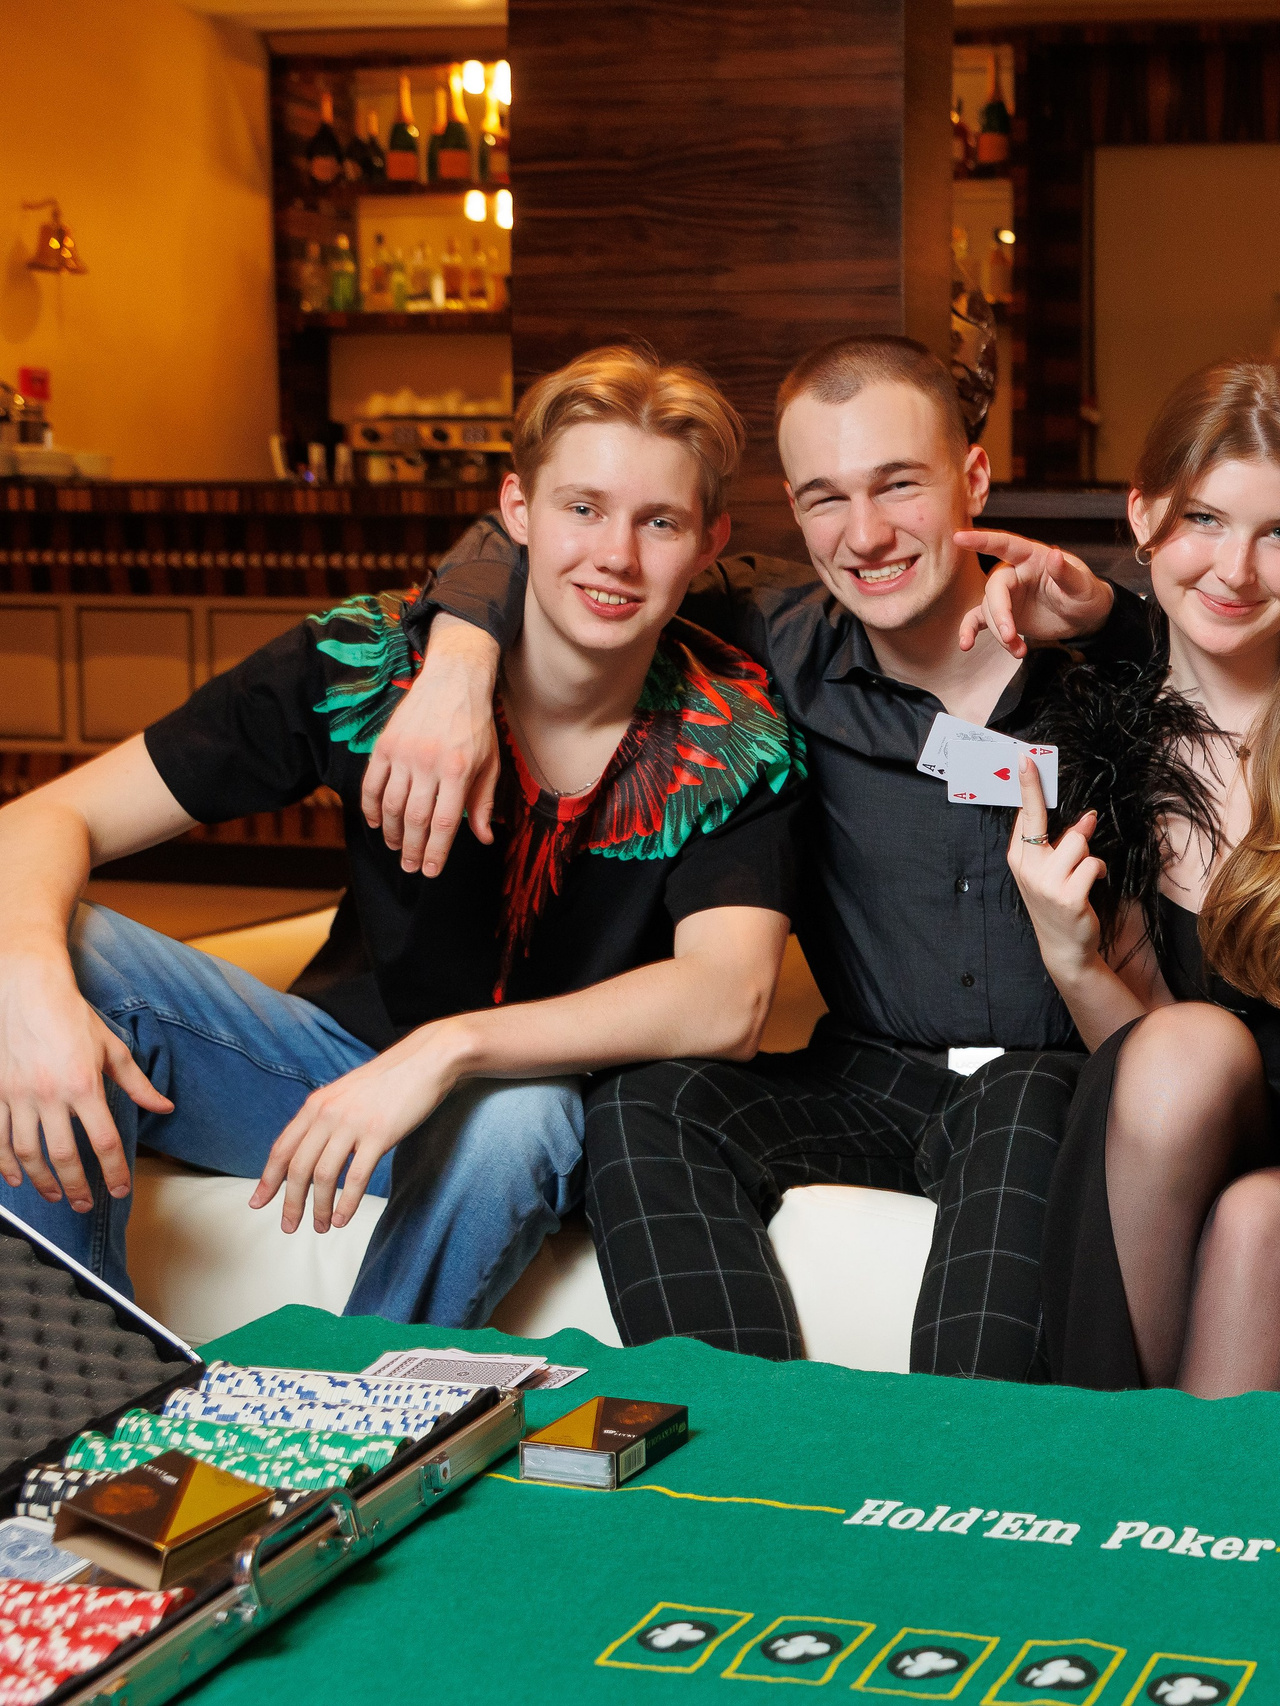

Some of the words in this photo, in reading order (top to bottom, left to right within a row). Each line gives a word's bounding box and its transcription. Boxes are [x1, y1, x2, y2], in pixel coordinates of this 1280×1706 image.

[1039, 747, 1053, 756] A
[922, 763, 936, 772] A
[953, 792, 967, 800] A
[844, 1499, 1081, 1546] Hold'Em
[1101, 1521, 1276, 1562] Poker
